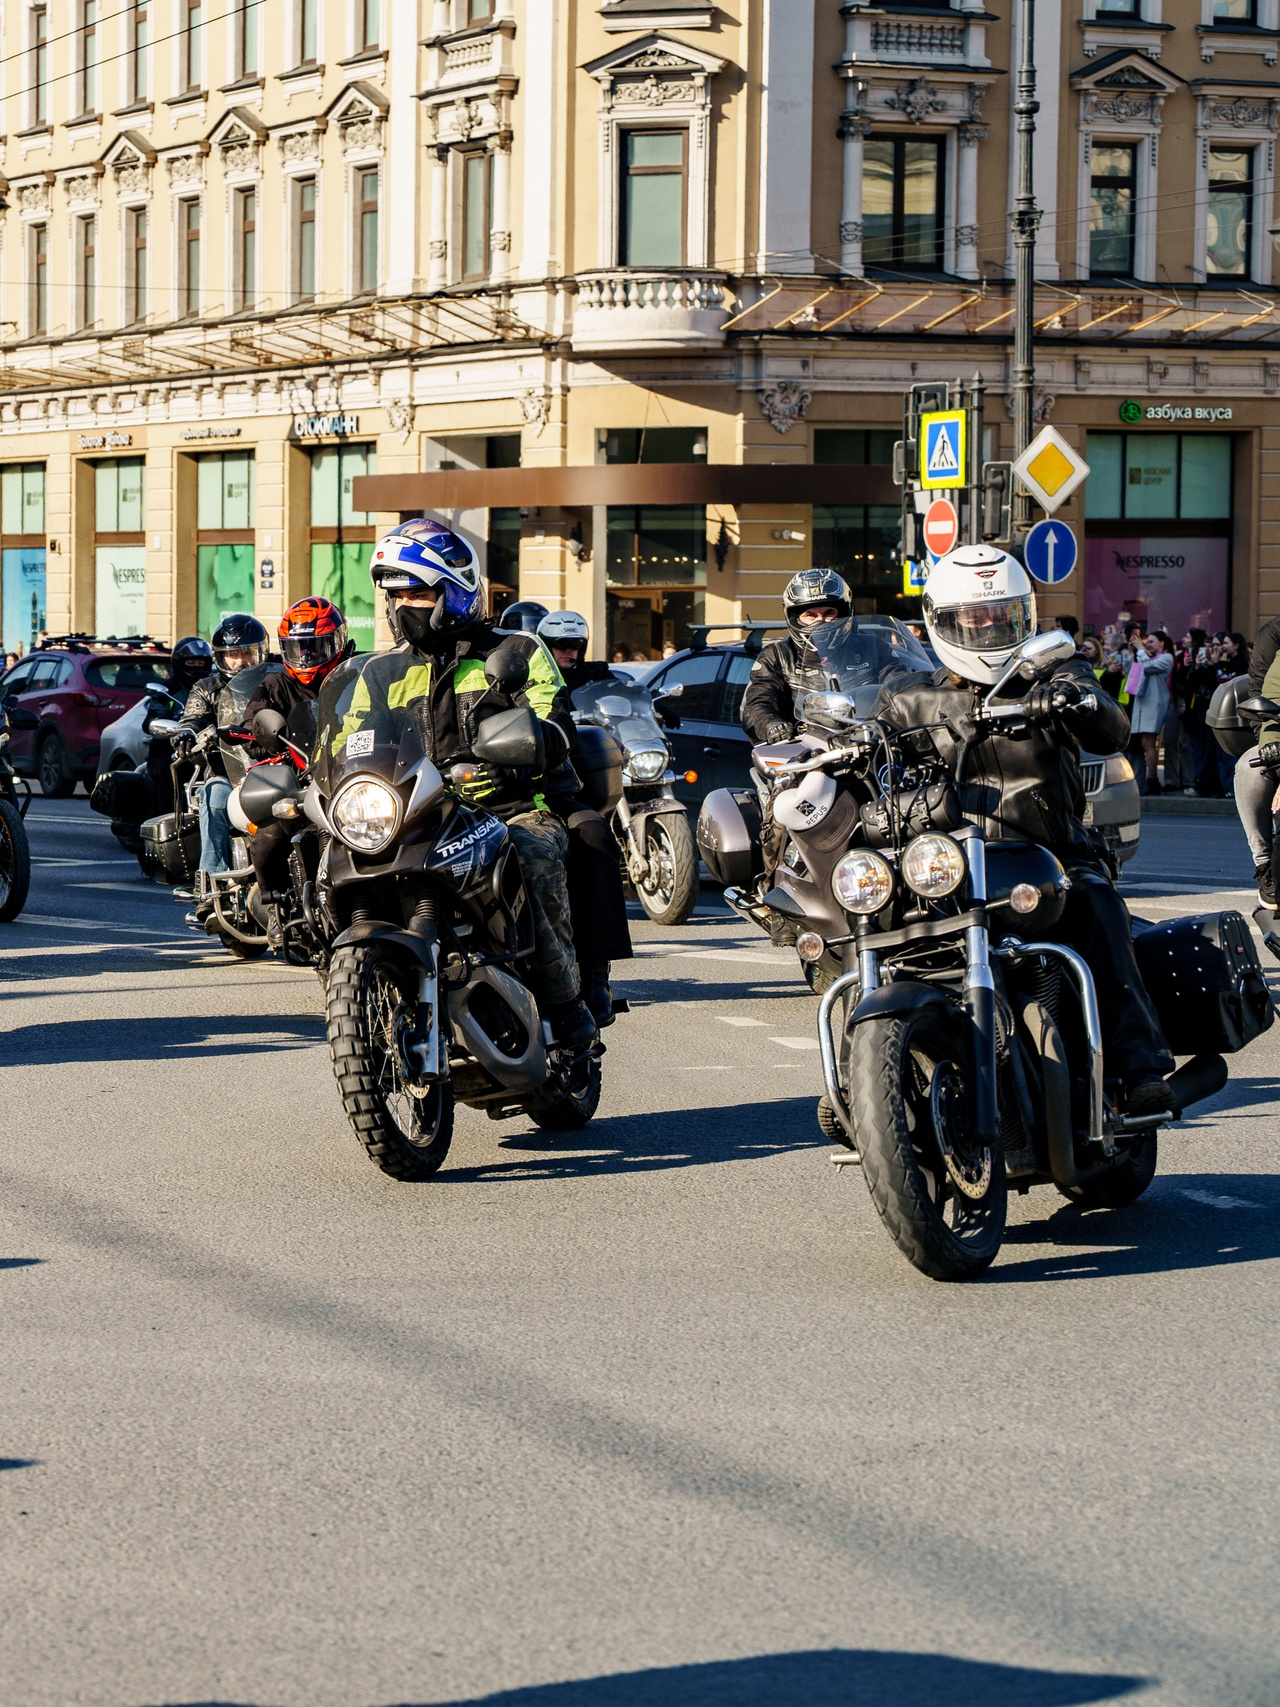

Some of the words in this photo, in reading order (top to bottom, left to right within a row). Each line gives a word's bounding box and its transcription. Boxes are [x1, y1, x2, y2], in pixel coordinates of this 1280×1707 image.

[1146, 403, 1192, 422] азбука
[1194, 407, 1232, 422] вкуса
[1112, 551, 1185, 573] NESPRESSO
[972, 589, 1007, 599] SHARK
[805, 805, 828, 826] REPUS
[436, 815, 501, 858] TRANSALP
